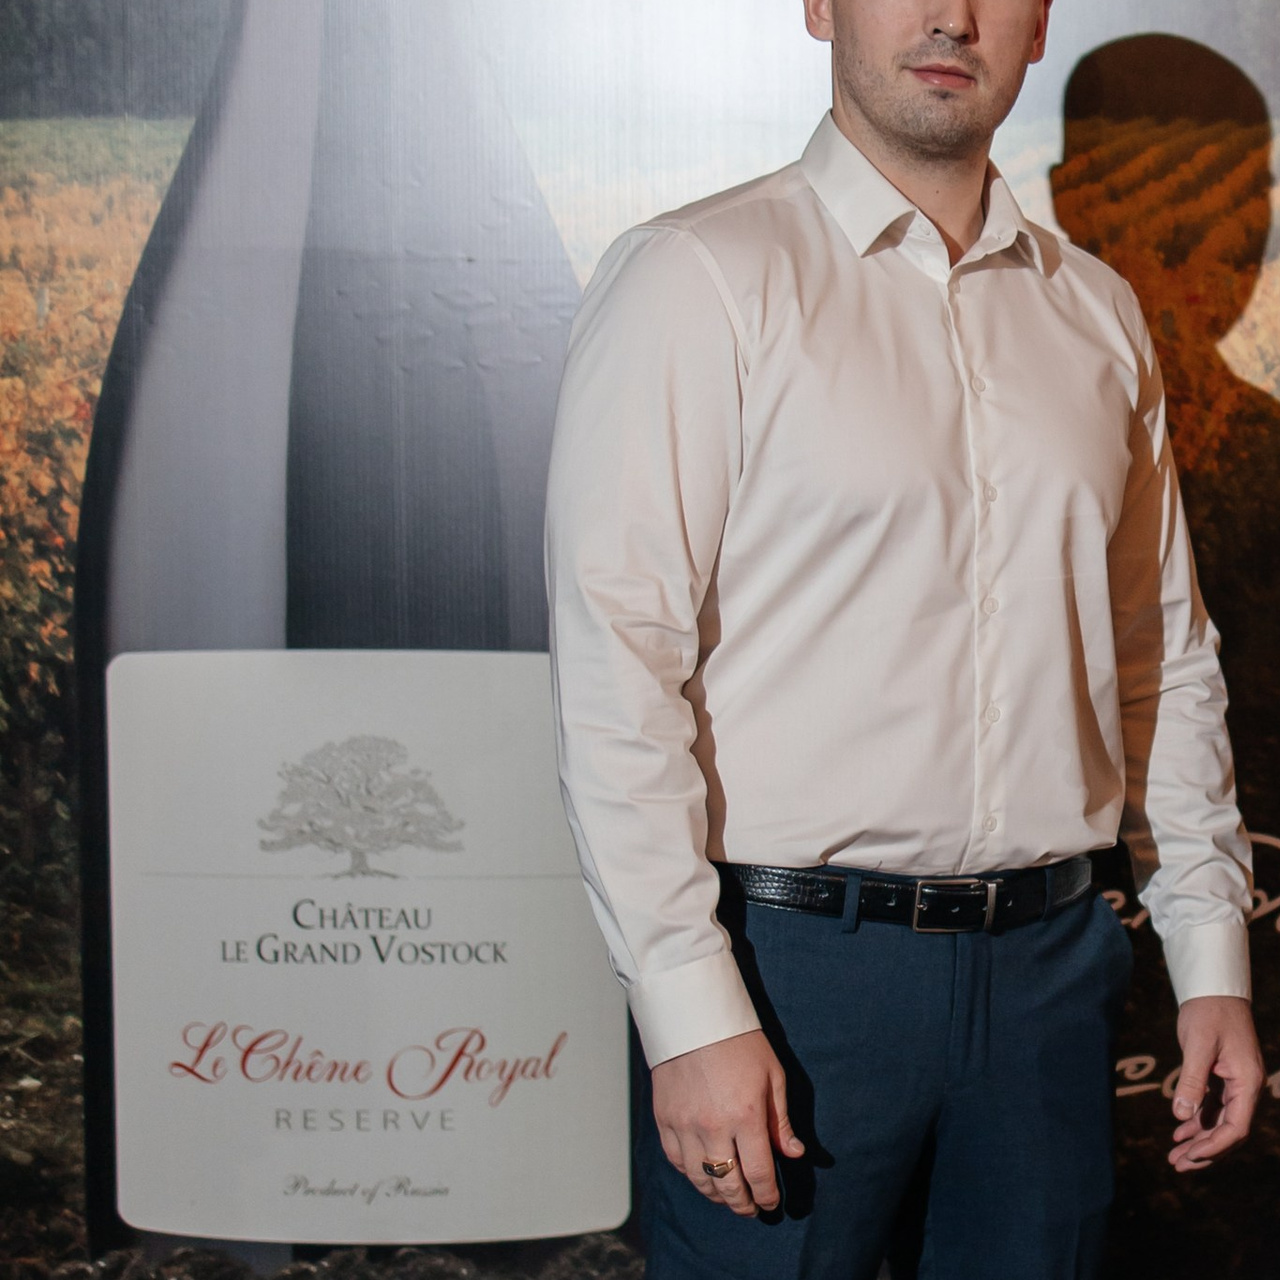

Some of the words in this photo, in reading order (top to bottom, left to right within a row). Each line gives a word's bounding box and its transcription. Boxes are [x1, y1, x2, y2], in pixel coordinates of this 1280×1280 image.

[291, 897, 433, 931] CHÂTEAU
[219, 939, 249, 964] LE
[255, 932, 362, 965] GRAND
[369, 934, 509, 965] VOSTOCK
[168, 1020, 229, 1085] Le
[230, 1023, 374, 1085] Chêne
[385, 1026, 569, 1109] Royal
[274, 1108, 456, 1134] RESERVE
